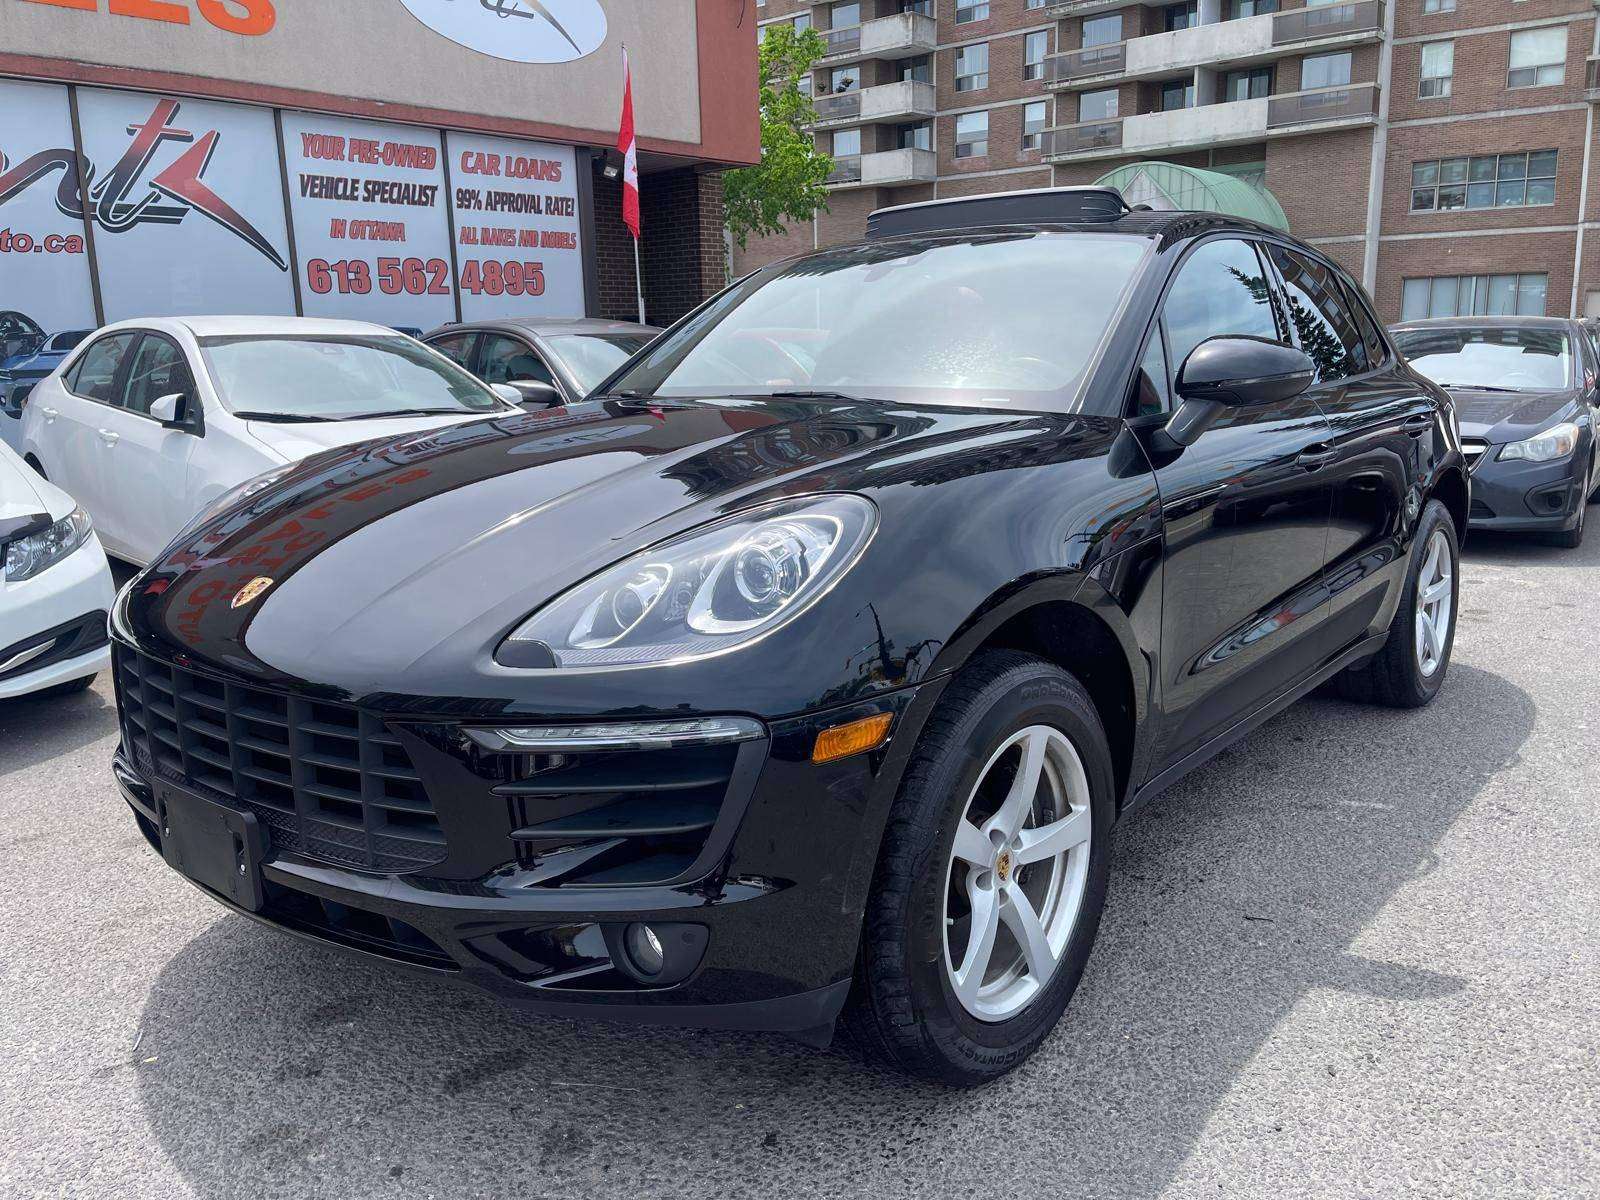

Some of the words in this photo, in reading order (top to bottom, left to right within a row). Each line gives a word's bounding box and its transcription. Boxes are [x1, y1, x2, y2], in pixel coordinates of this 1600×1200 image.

[301, 132, 345, 161] YOUR
[348, 138, 437, 170] PRE-OWNED
[461, 151, 500, 176] CAR
[504, 155, 562, 182] LOANS
[299, 174, 359, 201] VEHICLE
[362, 180, 438, 207] SPECIALIST
[456, 188, 482, 210] 99%
[485, 191, 543, 214] APPROVAL
[545, 195, 575, 216] RATE!
[330, 218, 347, 239] IN
[349, 220, 406, 241] OTTAWA
[460, 226, 478, 245] ALL
[481, 227, 516, 247] MAKES
[519, 229, 539, 248] AND
[541, 231, 577, 249] MODELS
[307, 258, 372, 295] 613
[377, 257, 449, 295] 562
[461, 260, 545, 296] 4895
